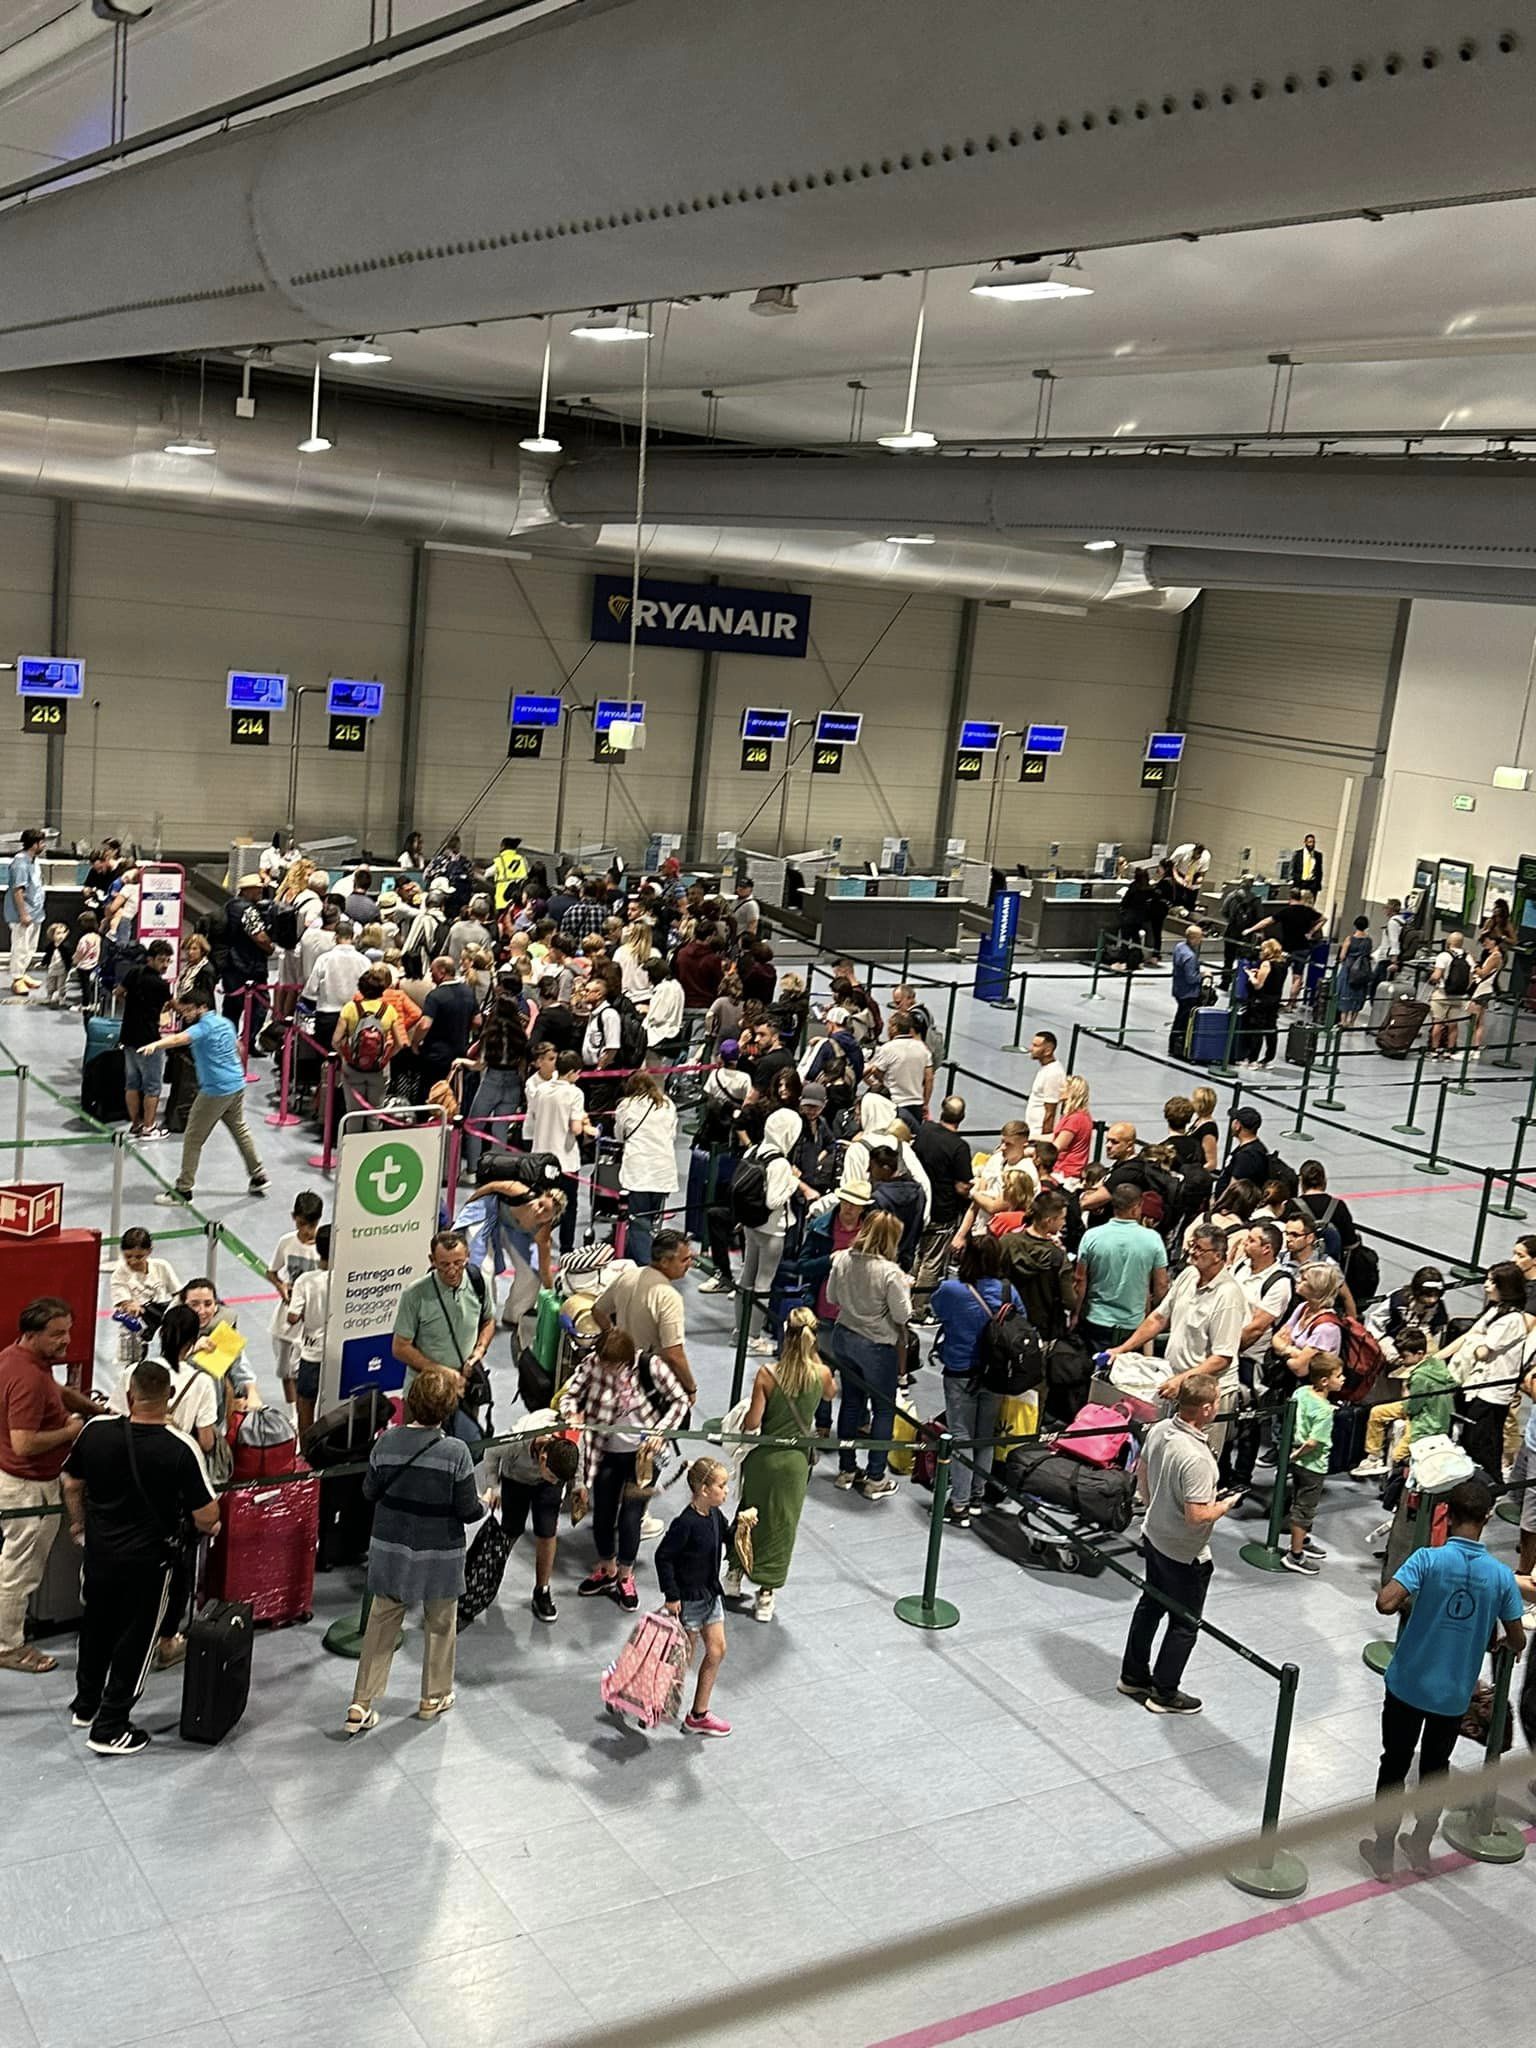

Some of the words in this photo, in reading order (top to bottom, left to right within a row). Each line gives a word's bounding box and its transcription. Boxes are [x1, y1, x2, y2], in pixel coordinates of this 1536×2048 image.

[634, 599, 798, 640] RYANAIR
[31, 705, 61, 723] 213
[237, 718, 264, 735] 214
[335, 724, 360, 741] 215
[514, 734, 538, 749] 216
[746, 747, 767, 762] 218
[817, 750, 839, 765] 219
[1144, 767, 1163, 780] 222
[999, 896, 1011, 942] RYANAIR
[352, 1218, 420, 1239] transavia
[347, 1267, 395, 1284] Entrega
[397, 1264, 413, 1276] de
[345, 1283, 402, 1300] bagagem
[344, 1298, 397, 1315] Baggage
[343, 1312, 392, 1331] drop-off
